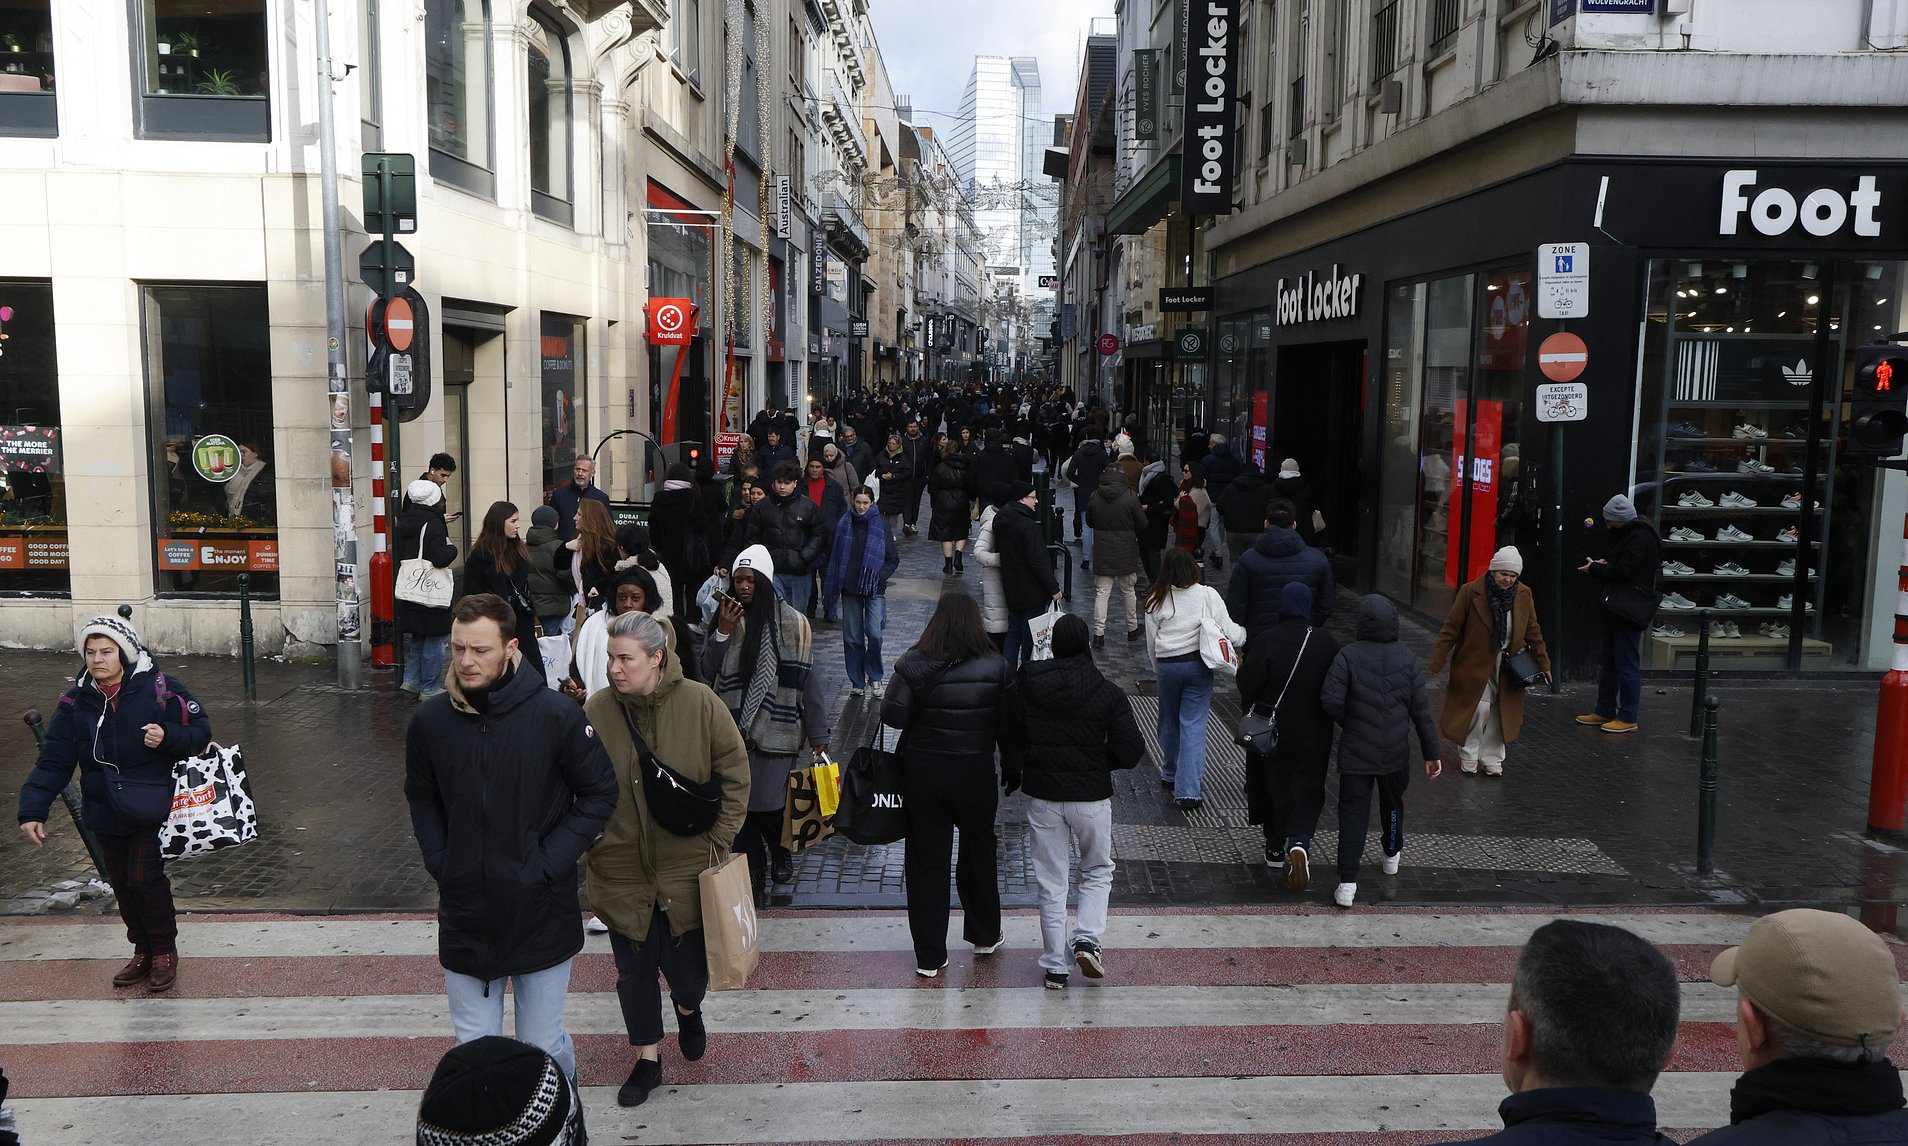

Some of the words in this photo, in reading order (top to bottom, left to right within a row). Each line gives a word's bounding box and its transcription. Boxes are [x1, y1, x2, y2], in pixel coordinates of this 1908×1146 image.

[1197, 2, 1228, 112] Locker
[1194, 124, 1223, 194] Foot
[780, 179, 789, 235] Australian
[1719, 169, 1881, 237] Foot
[815, 233, 823, 292] CALZEDONIA
[1552, 246, 1577, 254] ZONE
[1276, 276, 1303, 327] Foot
[1307, 263, 1360, 320] Locker
[1, 446, 17, 454] THE
[6, 440, 22, 448] THE
